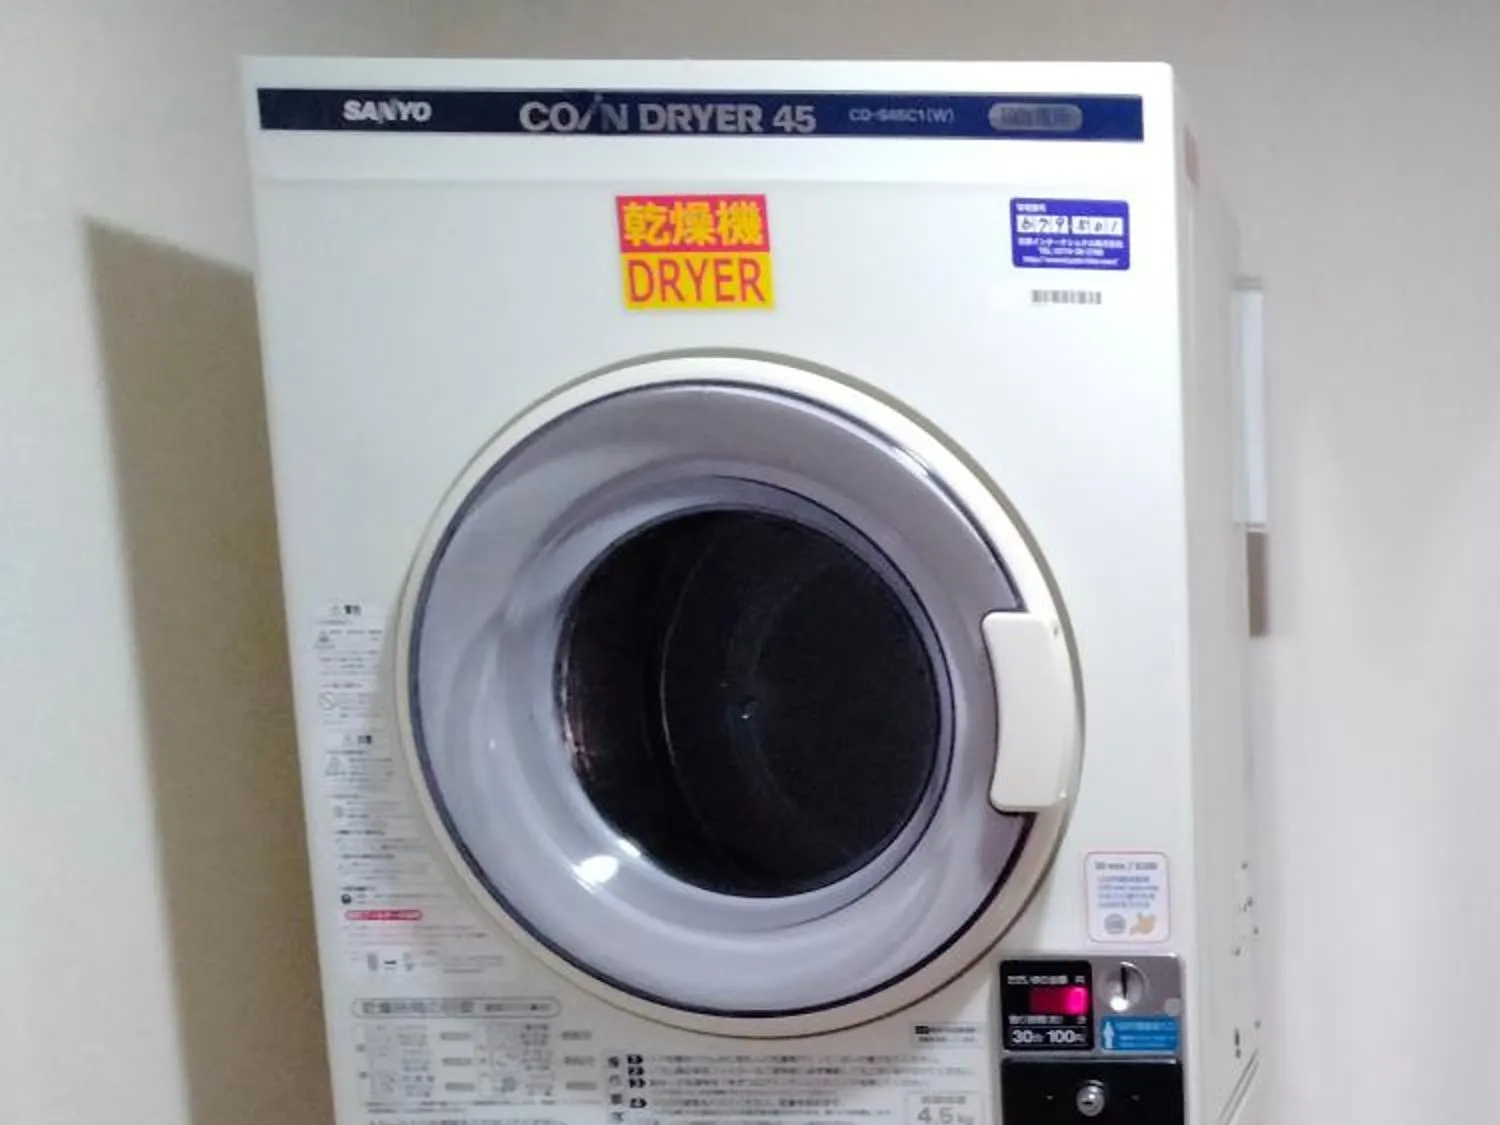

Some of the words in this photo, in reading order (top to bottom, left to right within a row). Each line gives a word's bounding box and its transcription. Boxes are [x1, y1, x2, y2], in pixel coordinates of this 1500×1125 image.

[342, 98, 432, 123] SANYO
[518, 95, 628, 132] COIN
[638, 103, 763, 133] DRYER
[773, 105, 816, 133] 45
[622, 201, 764, 246] 乾燥機
[627, 258, 766, 302] DRYER
